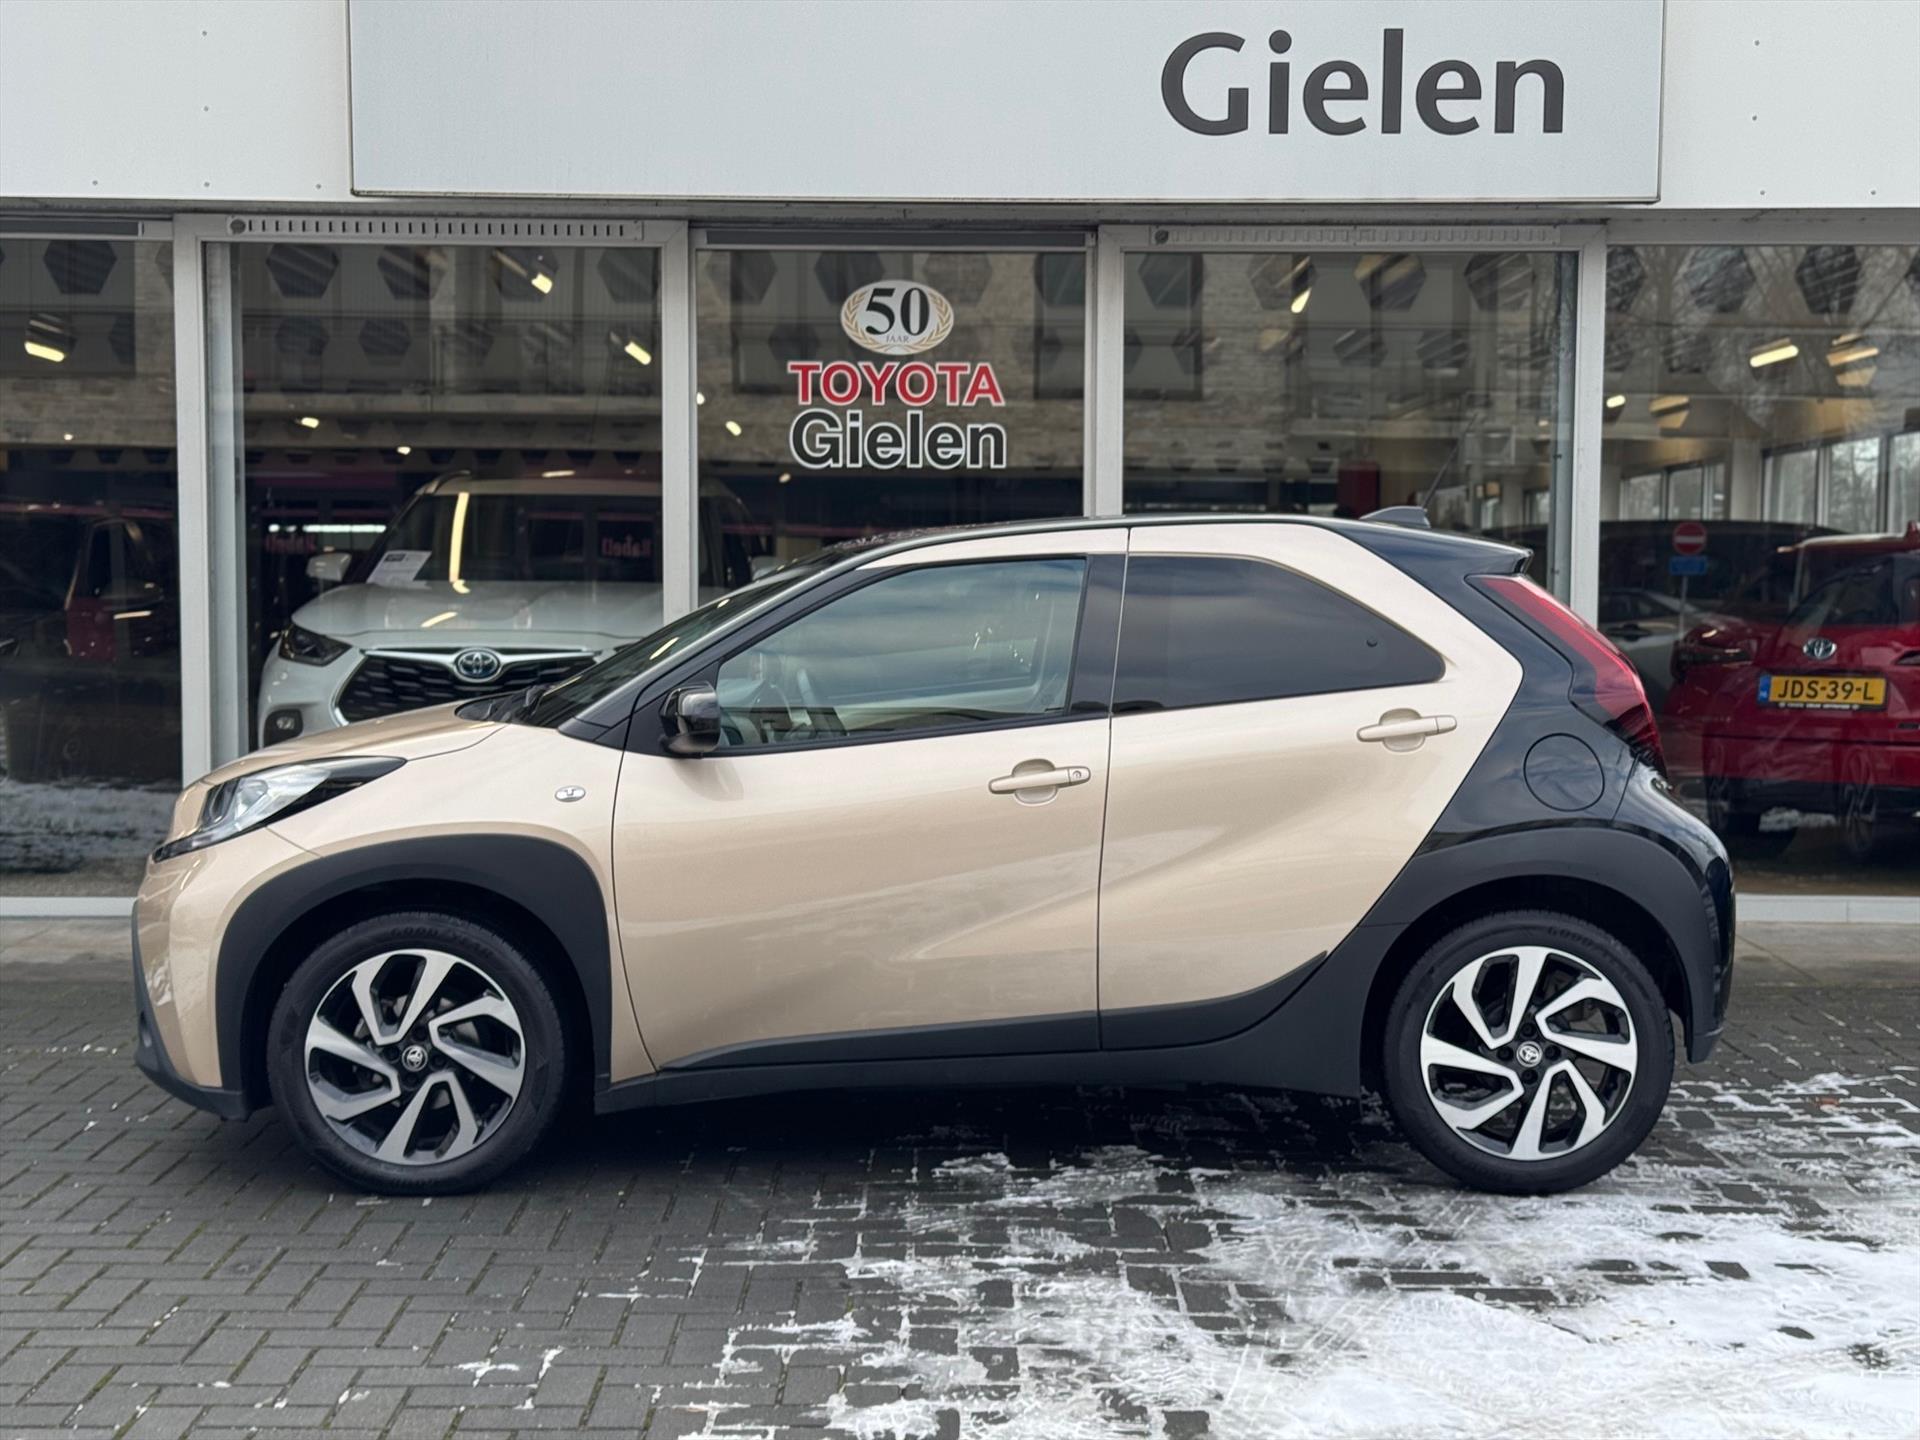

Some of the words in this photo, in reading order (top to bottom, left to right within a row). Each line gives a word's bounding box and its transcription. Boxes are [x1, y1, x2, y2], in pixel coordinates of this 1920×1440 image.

[1161, 28, 1565, 136] Gielen
[865, 287, 930, 336] 50
[886, 335, 910, 343] JAAR
[788, 361, 1005, 406] TOYOTA
[790, 408, 1007, 469] Gielen
[1778, 680, 1874, 701] JDS-39-L
